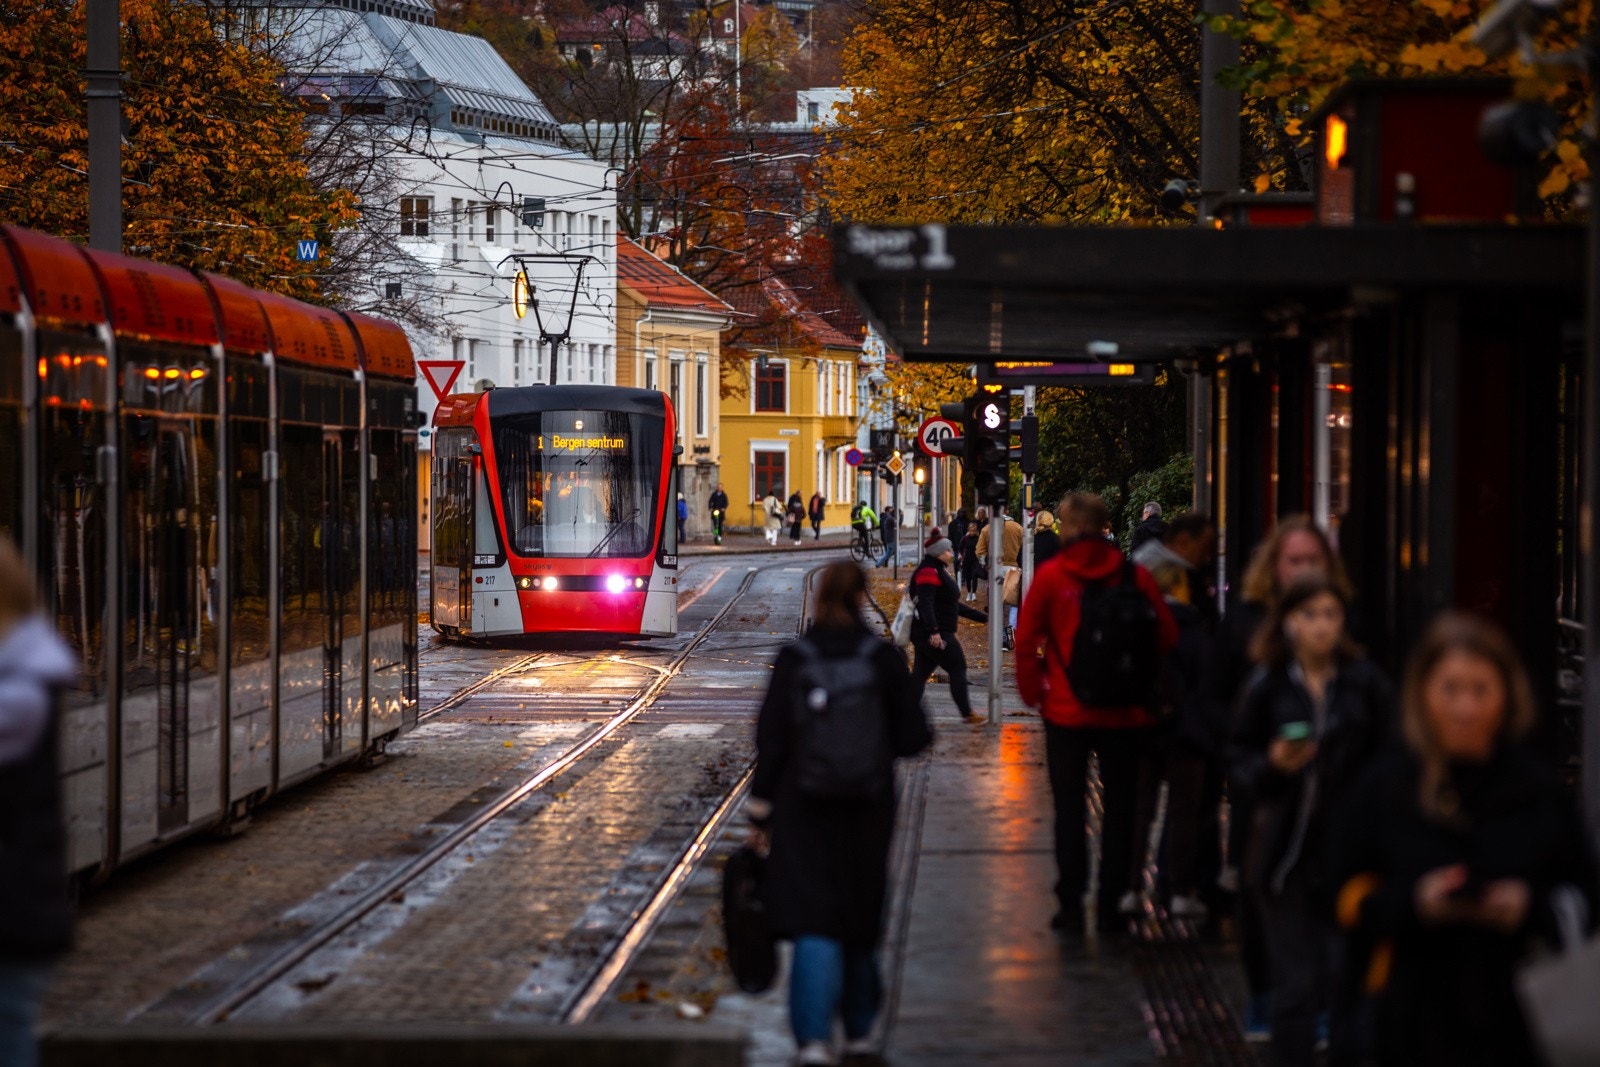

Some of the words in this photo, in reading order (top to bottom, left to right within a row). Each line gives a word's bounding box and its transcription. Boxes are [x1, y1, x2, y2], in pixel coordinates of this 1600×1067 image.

[298, 242, 317, 259] W
[921, 224, 956, 269] 1
[537, 436, 544, 449] 1
[553, 434, 586, 451] Bergen
[587, 434, 624, 449] sentrum
[925, 426, 953, 447] 40
[485, 575, 496, 585] 217
